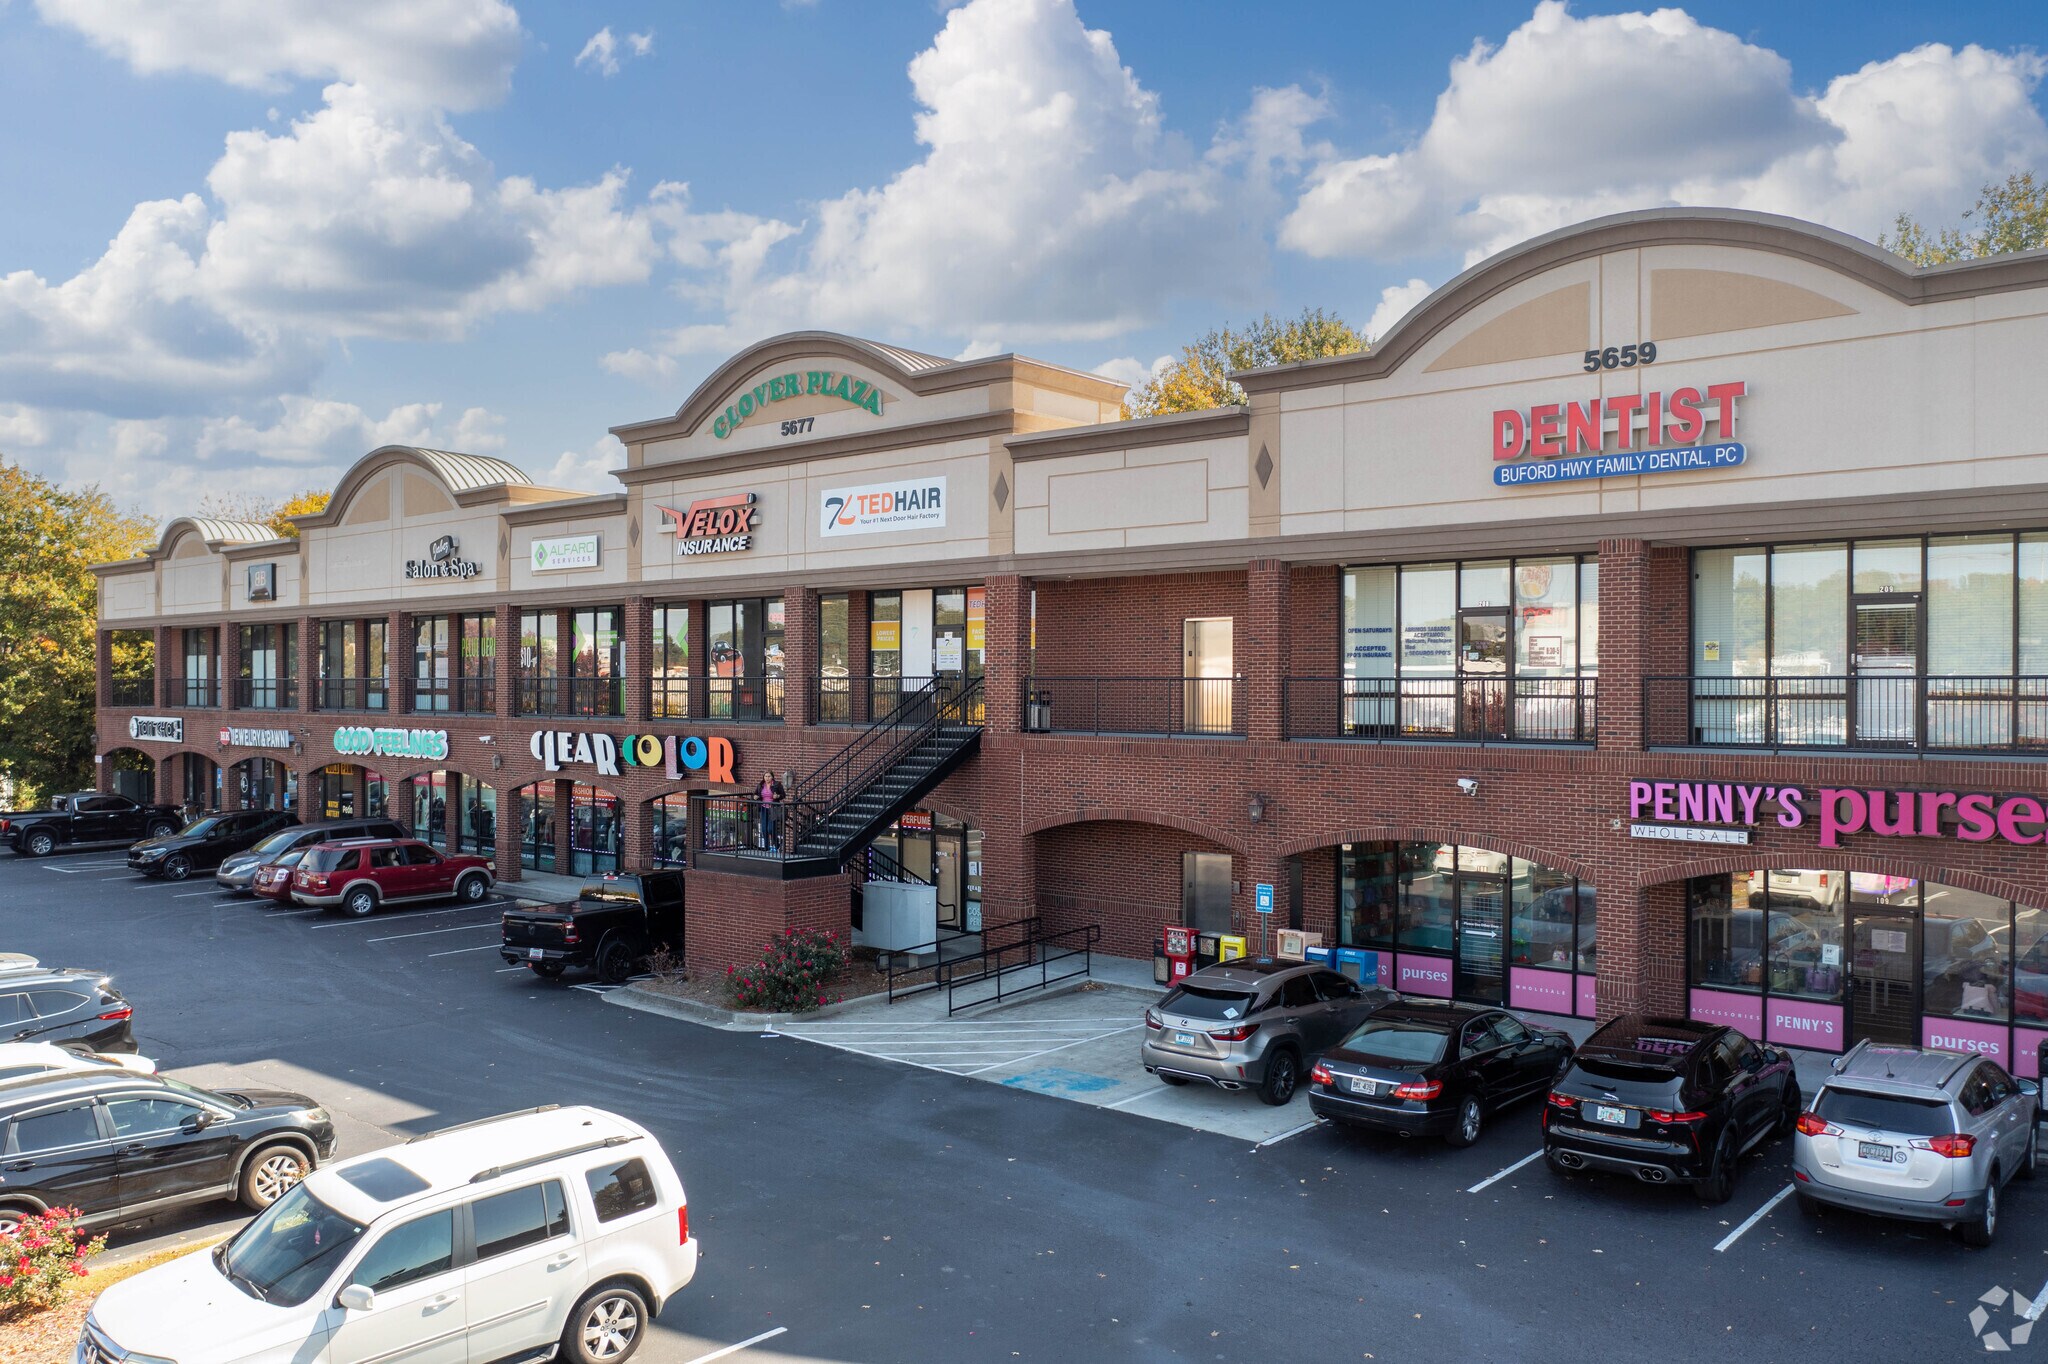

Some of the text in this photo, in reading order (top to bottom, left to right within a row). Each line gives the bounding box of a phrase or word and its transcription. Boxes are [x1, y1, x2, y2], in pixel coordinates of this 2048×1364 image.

[1584, 341, 1657, 373] 5659
[713, 371, 884, 440] CLOVER PLAZA
[781, 417, 815, 437] 5677
[1493, 381, 1748, 461] DENTIST
[1501, 446, 1738, 483] BUFORD HWY FAMILY DENTAL, PC
[857, 487, 941, 515] TEDHAIR
[655, 493, 757, 539] VELOX
[550, 541, 595, 556] ALFARO
[677, 536, 750, 556] INSURANCE
[406, 557, 476, 579] Salon & Spa
[552, 556, 591, 564] SERVICES
[333, 727, 448, 760] GOOD FEELINGS
[530, 730, 735, 784] CLEAR COLOR
[572, 786, 593, 795] FASHION
[902, 814, 931, 825] PERFUME
[1630, 781, 2048, 850] PENNY'S purse
[1634, 826, 1745, 844] WHOLESALE
[1876, 897, 1890, 905] 109
[1402, 967, 1448, 982] purses
[1516, 984, 1566, 996] WHOLESALE
[1691, 1007, 1761, 1021] ACCESSORIES
[1775, 1014, 1834, 1034] PENNY'S
[1930, 1034, 2000, 1054] purses
